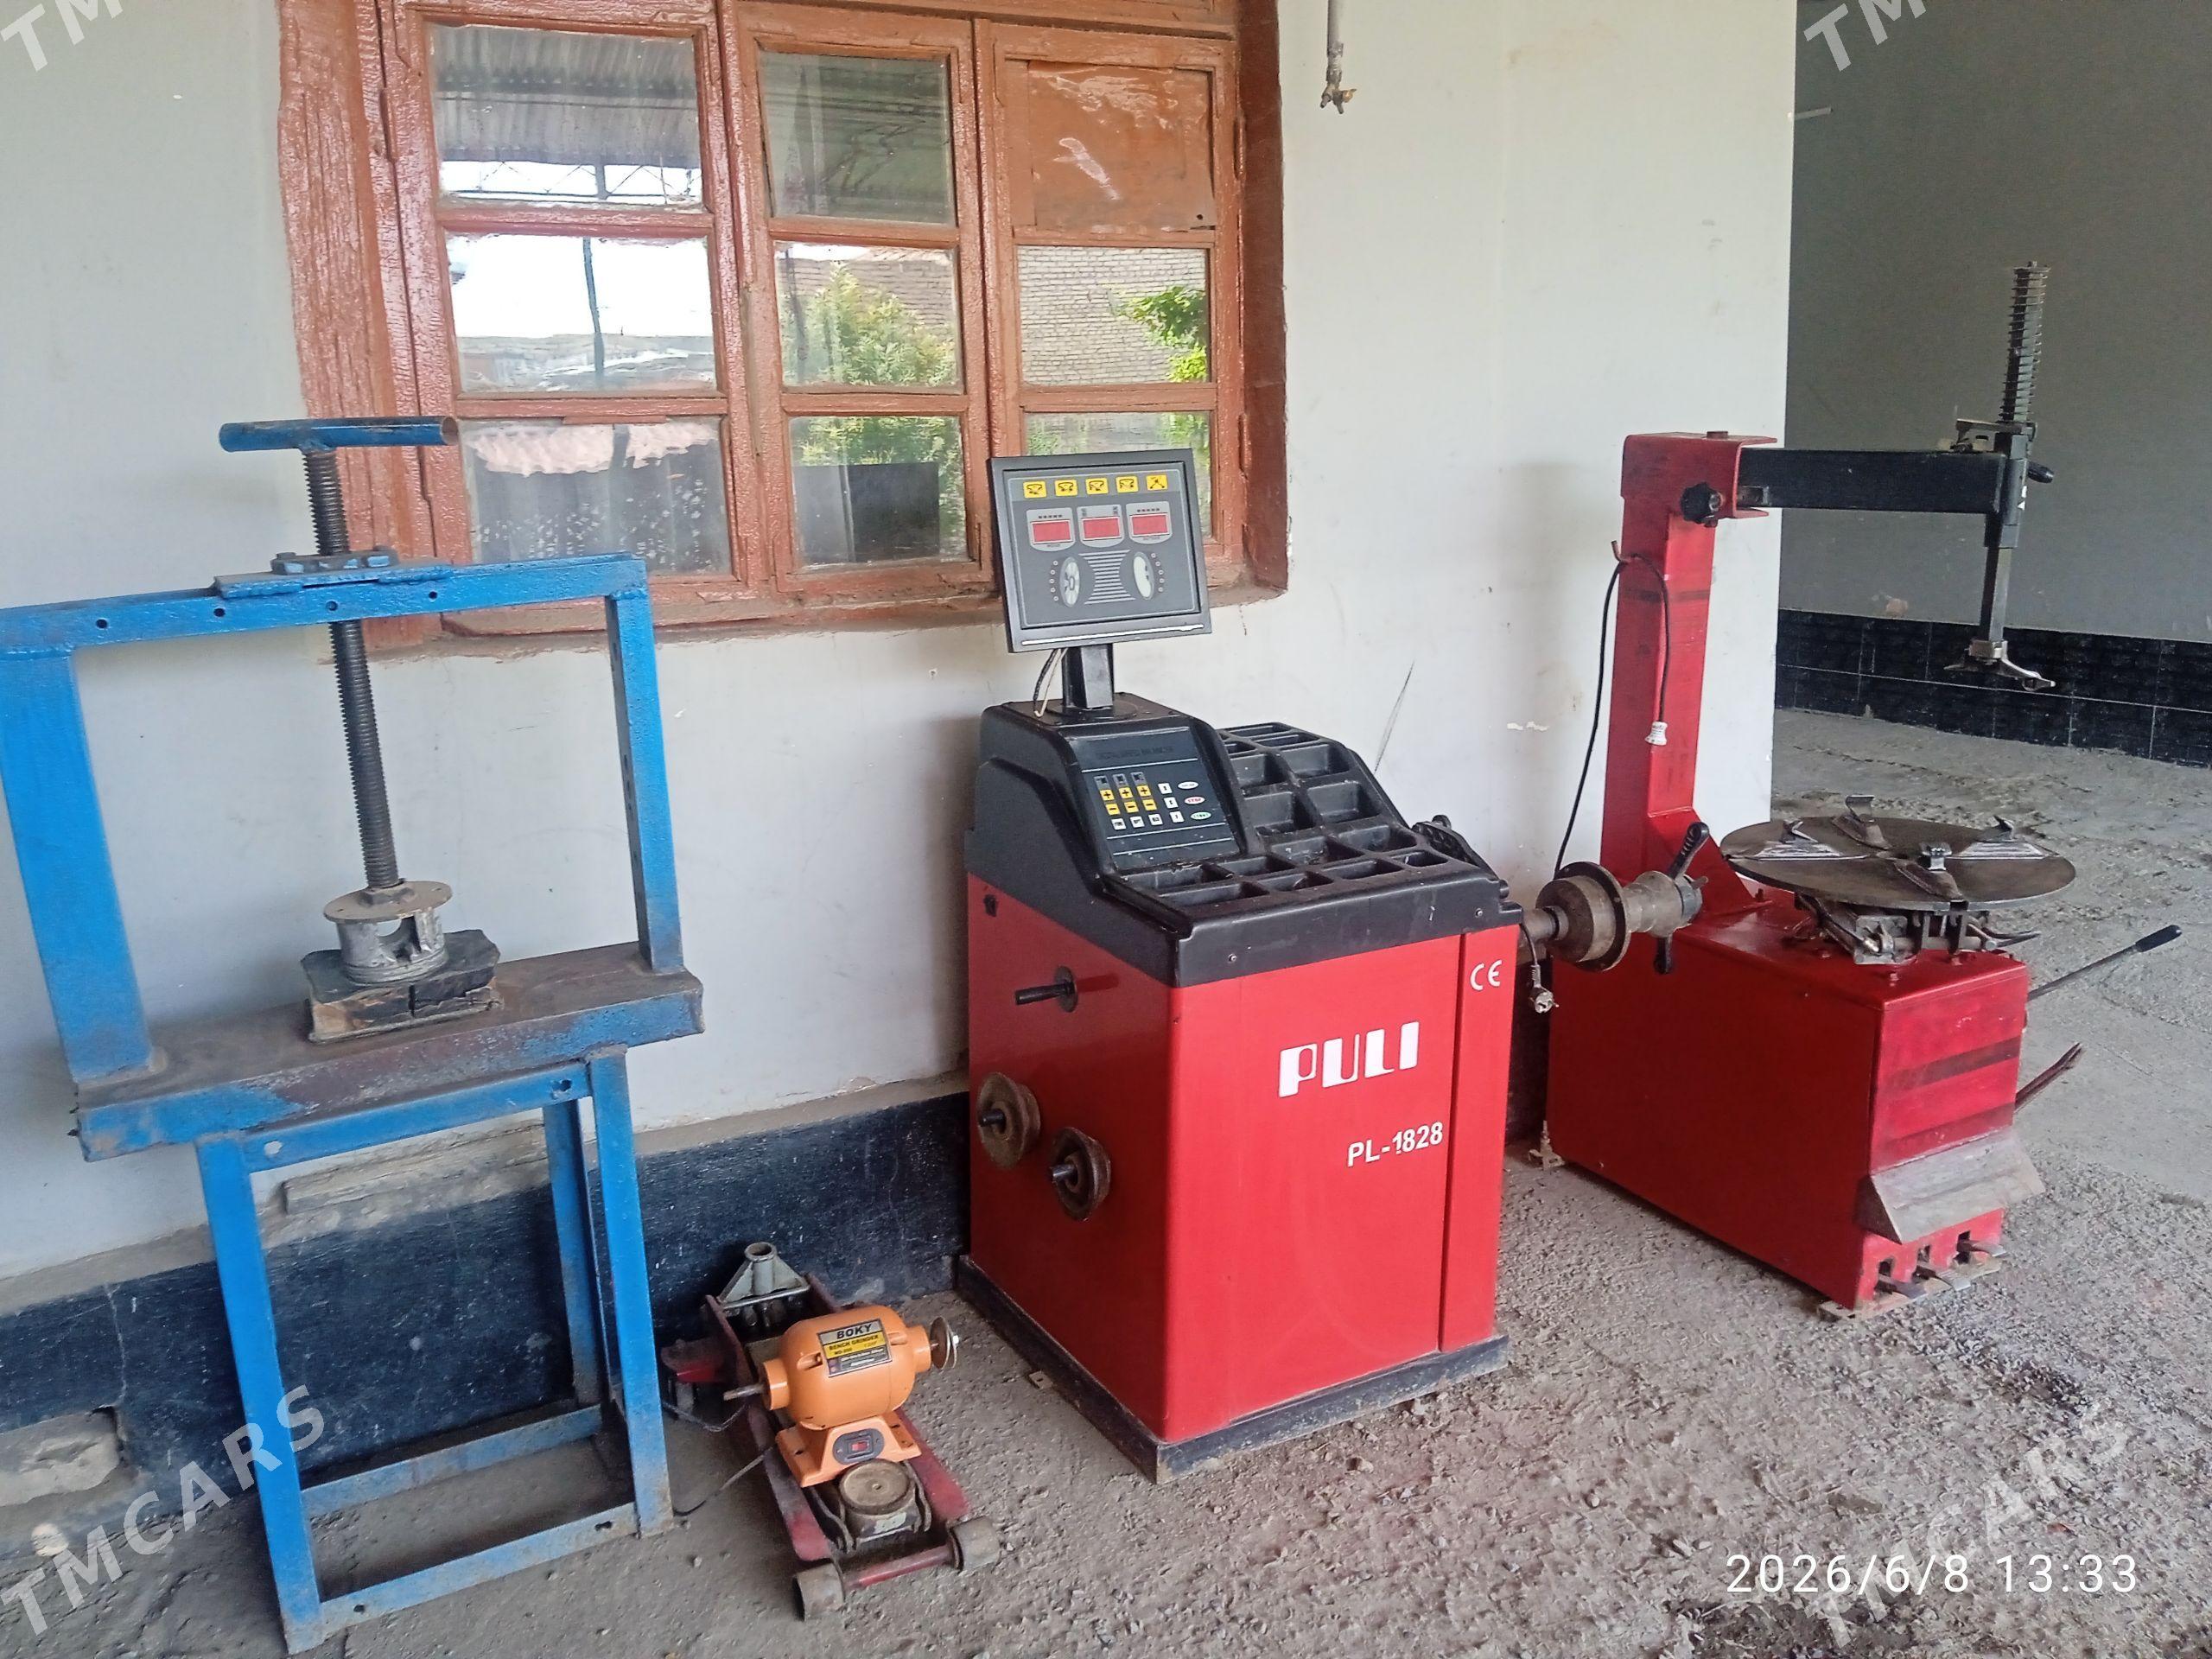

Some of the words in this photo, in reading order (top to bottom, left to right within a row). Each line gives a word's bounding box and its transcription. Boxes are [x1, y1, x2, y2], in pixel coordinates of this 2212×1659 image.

[1470, 959, 1503, 991] CE
[1278, 1020, 1420, 1098] PULI
[836, 1324, 872, 1339] BOKY
[829, 1341, 850, 1351] BENCH
